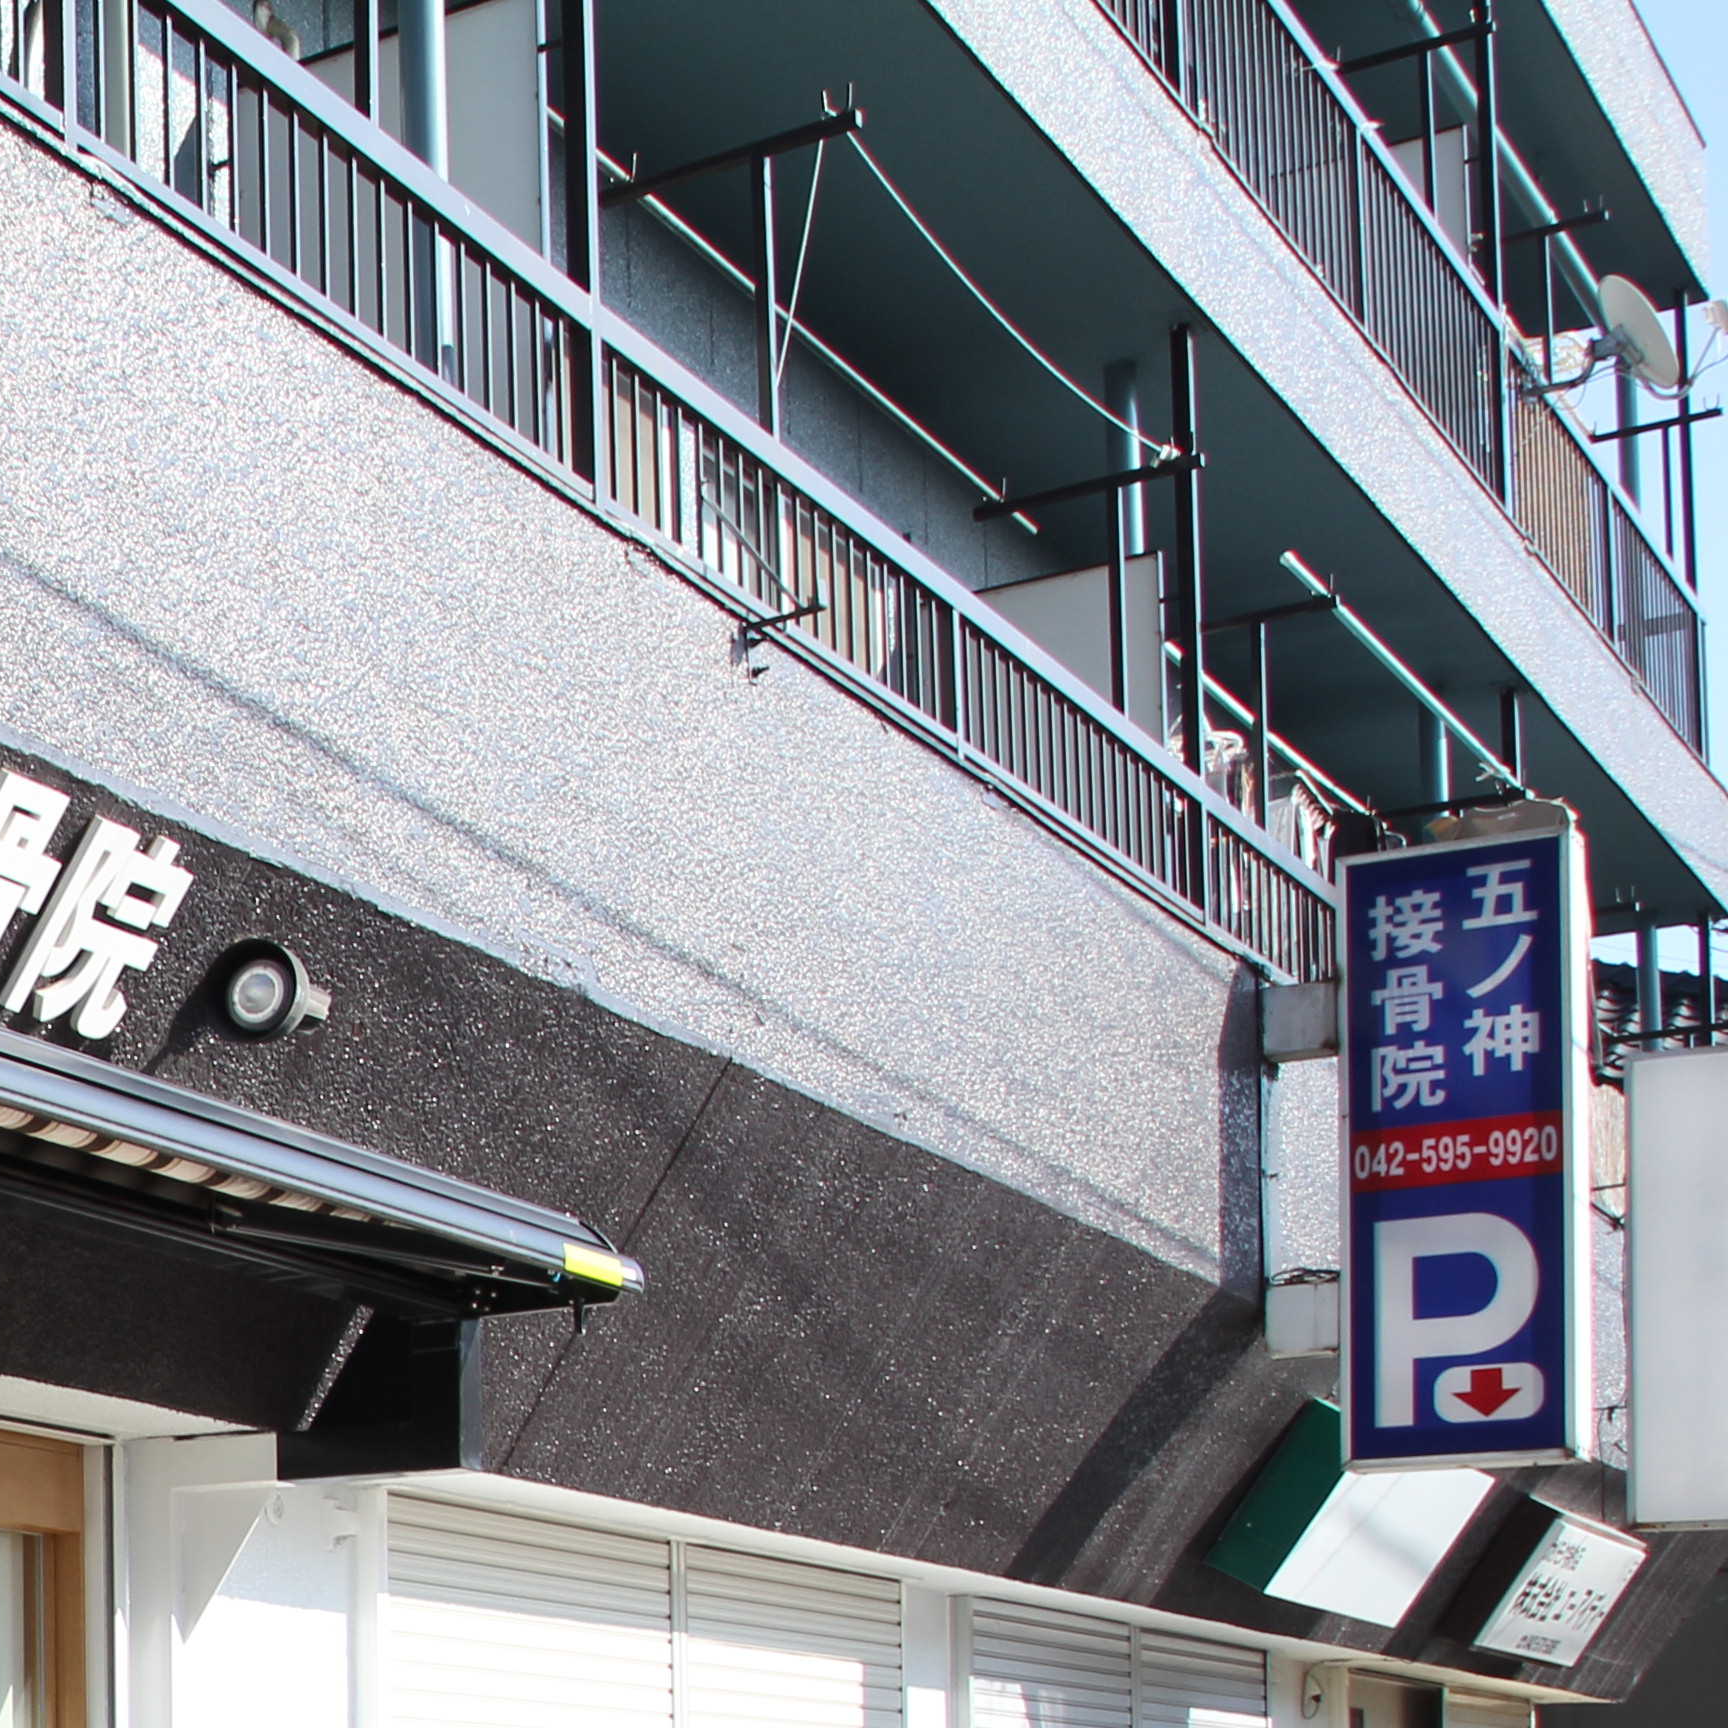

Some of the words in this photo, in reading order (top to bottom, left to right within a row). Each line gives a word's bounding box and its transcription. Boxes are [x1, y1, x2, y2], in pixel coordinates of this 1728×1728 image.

[1367, 891, 1445, 1112] 接骨院
[1461, 858, 1540, 1077] 五ノ神
[1354, 1125, 1558, 1181] 042-595-9920
[1374, 1212, 1540, 1428] P
